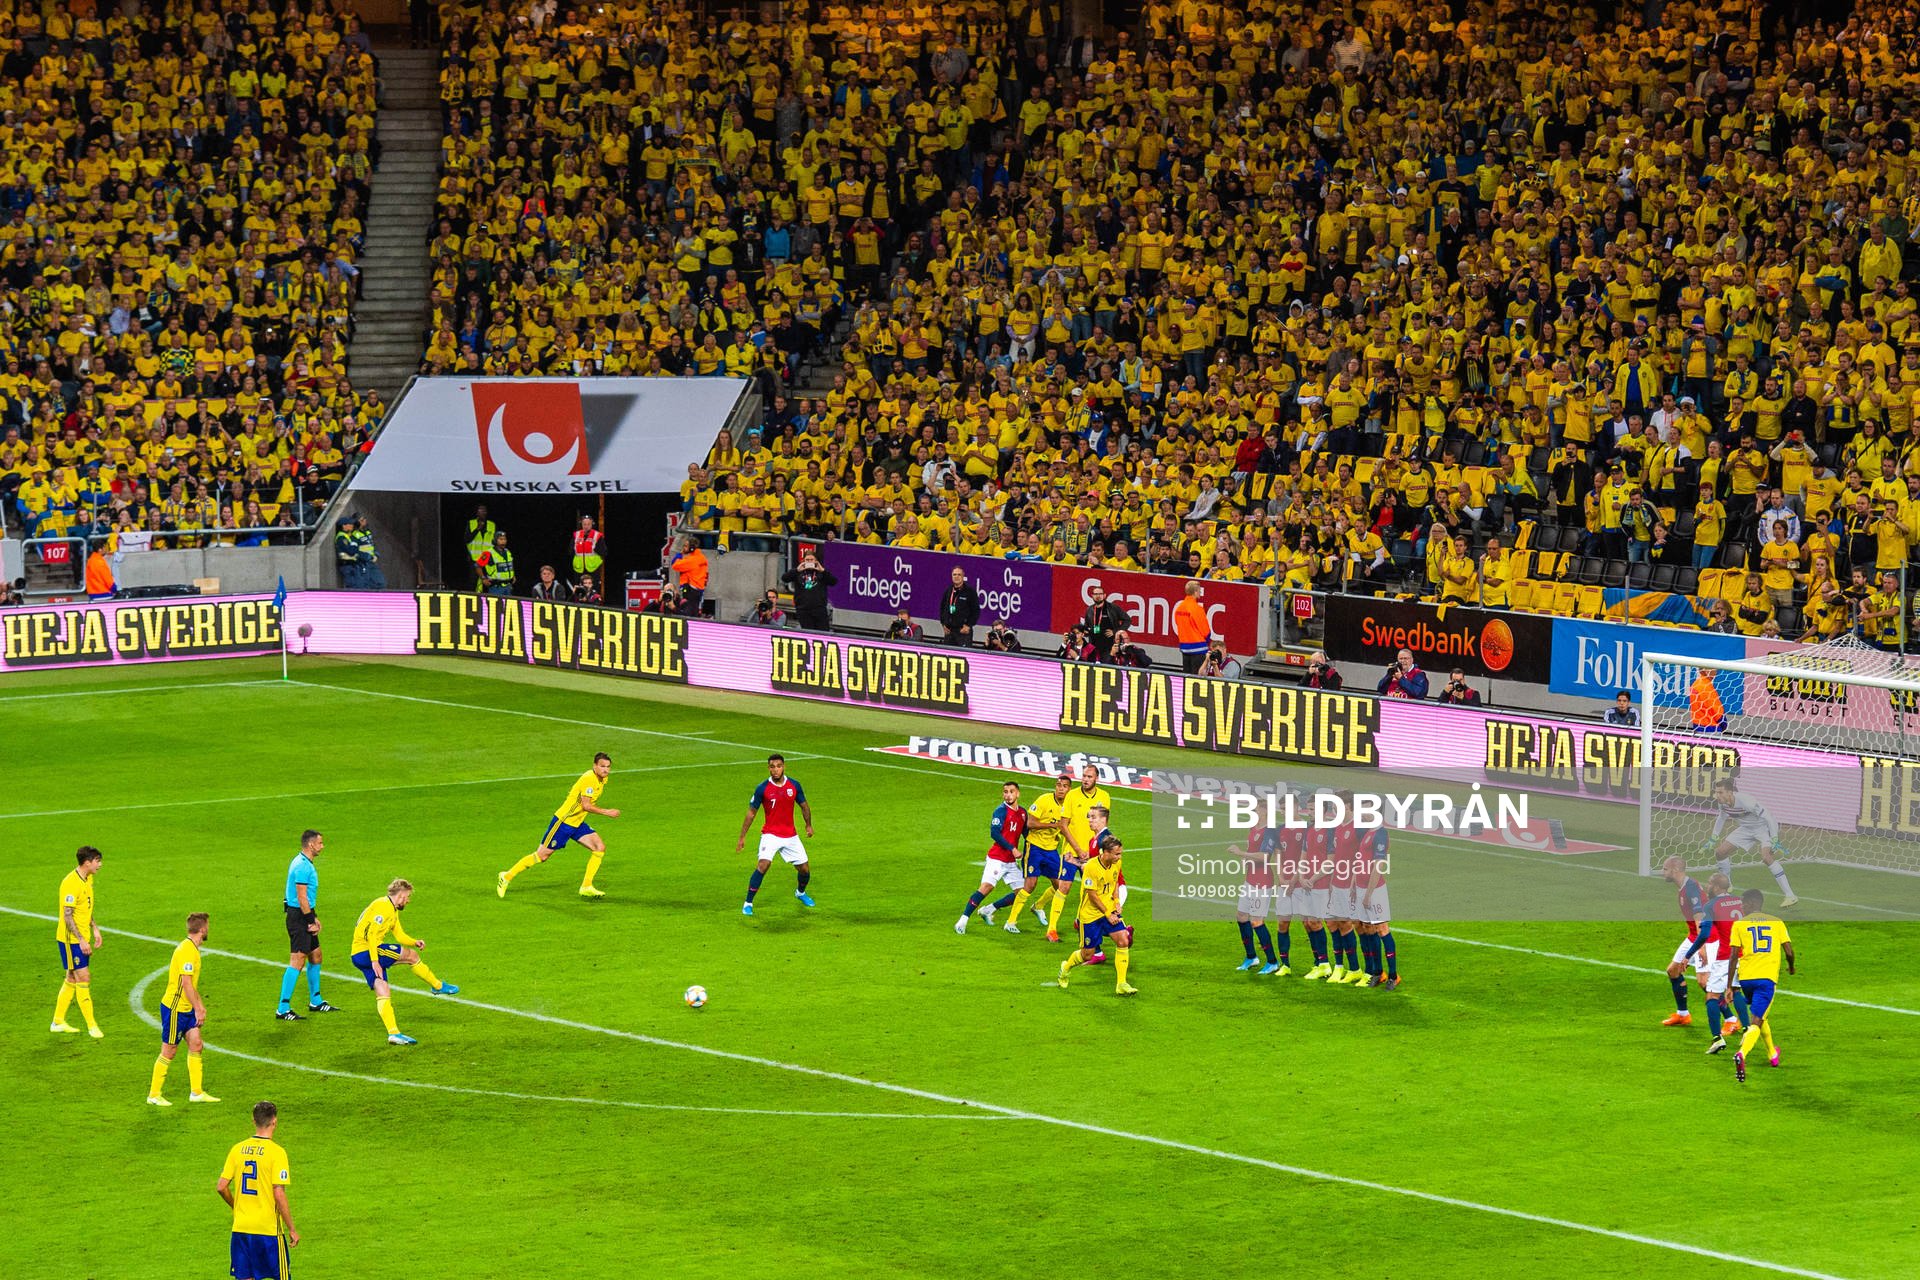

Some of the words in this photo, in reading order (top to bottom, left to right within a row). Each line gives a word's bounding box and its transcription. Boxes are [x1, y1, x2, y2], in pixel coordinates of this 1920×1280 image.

[450, 480, 560, 492] SVENSKA
[571, 480, 628, 491] SPEL
[46, 547, 66, 559] 107
[849, 564, 912, 608] Fabege
[963, 577, 1021, 621] bege
[1296, 600, 1310, 611] 102
[4, 610, 108, 659] HEJA
[116, 600, 280, 652] SVERIGE
[416, 592, 524, 657] HEJA
[532, 601, 683, 678] SVERIGE
[1361, 617, 1475, 656] Swedbank
[771, 636, 841, 689] HEJA
[847, 646, 965, 704] SVERIGE
[1061, 662, 1171, 738] HEJA
[1183, 677, 1374, 763] SVERIGE
[1769, 699, 1848, 718] BLADET
[908, 736, 1062, 776] Framåt
[1067, 752, 1138, 785] för
[1486, 722, 1574, 781] HEJA
[770, 799, 776, 809] 7
[1009, 821, 1017, 832] 14
[1747, 925, 1772, 953] 15
[241, 1160, 258, 1196] 2
